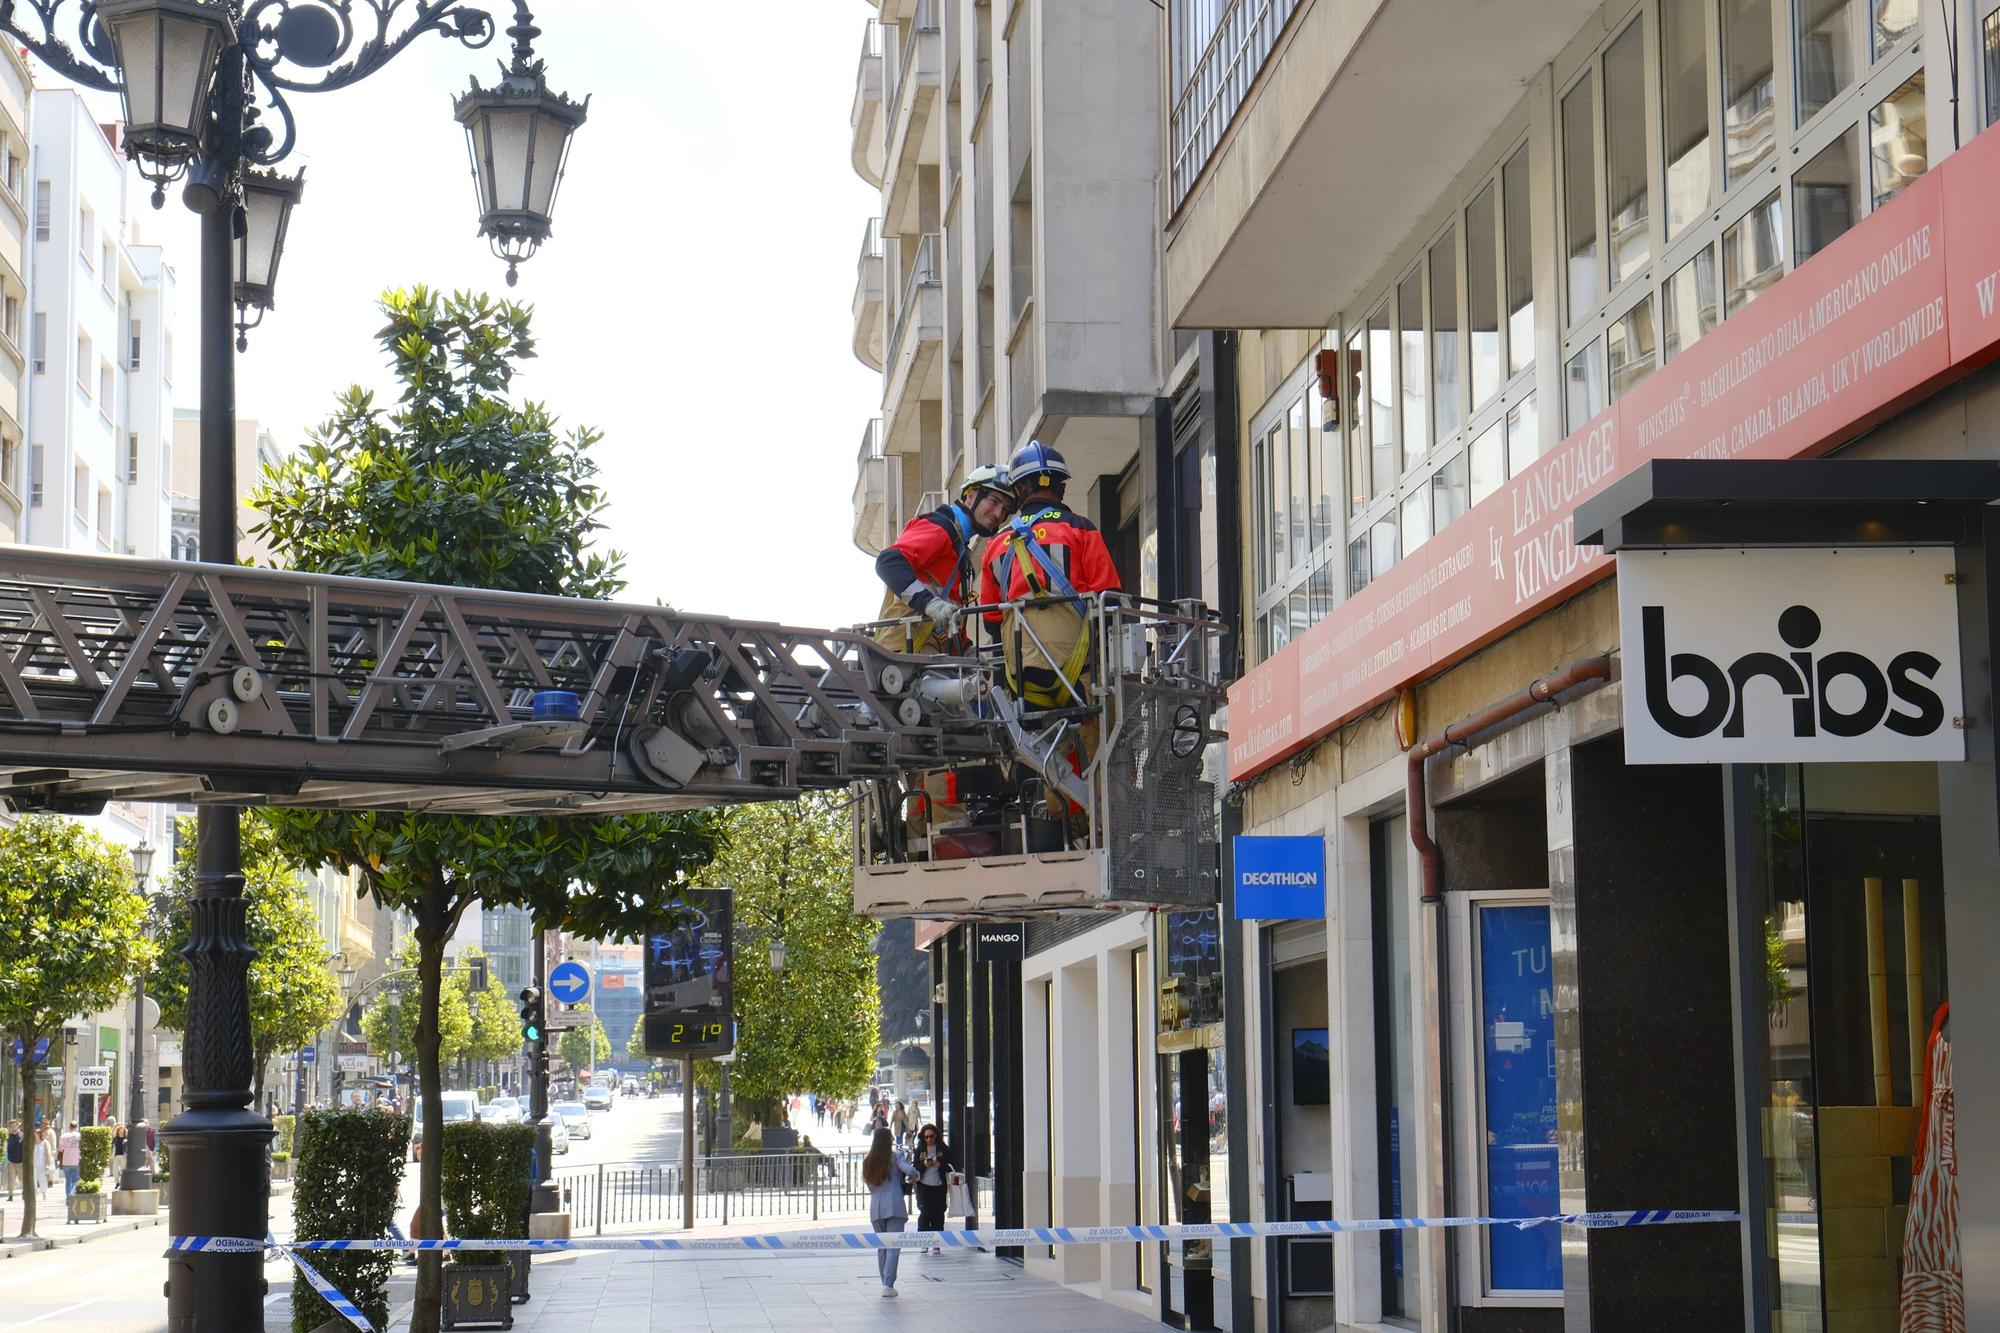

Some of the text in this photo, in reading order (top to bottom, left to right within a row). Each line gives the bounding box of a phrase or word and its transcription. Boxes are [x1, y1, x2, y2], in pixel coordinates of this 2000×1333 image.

[1700, 333, 1775, 408] BACHILLERATO
[1776, 312, 1806, 356] DUAL
[1808, 262, 1879, 337] AMERICANO
[1881, 224, 1931, 286] ONLINE
[1731, 396, 1776, 454] CANADÁ,
[1777, 372, 1830, 428] IRLANDA,
[1832, 356, 1850, 393] UK
[1851, 348, 1860, 382] Y
[1861, 296, 1944, 375] WORLDWIDE
[1512, 418, 1615, 537] LANGUAGE
[1438, 540, 1473, 585] EXTRANJERO
[1514, 515, 1606, 605] KINGD
[1374, 637, 1403, 674] EXTRANJERO
[1409, 614, 1439, 652] ACADEMIAS
[1439, 609, 1446, 634] DE
[1447, 593, 1471, 629] IDIOMAS
[1642, 604, 1945, 739] brios
[1242, 871, 1317, 886] DECATHLON
[981, 934, 1020, 942] MANGO
[1511, 945, 1547, 977] TU
[83, 1078, 103, 1086] ORO
[1593, 1219, 1618, 1227] POLICIA
